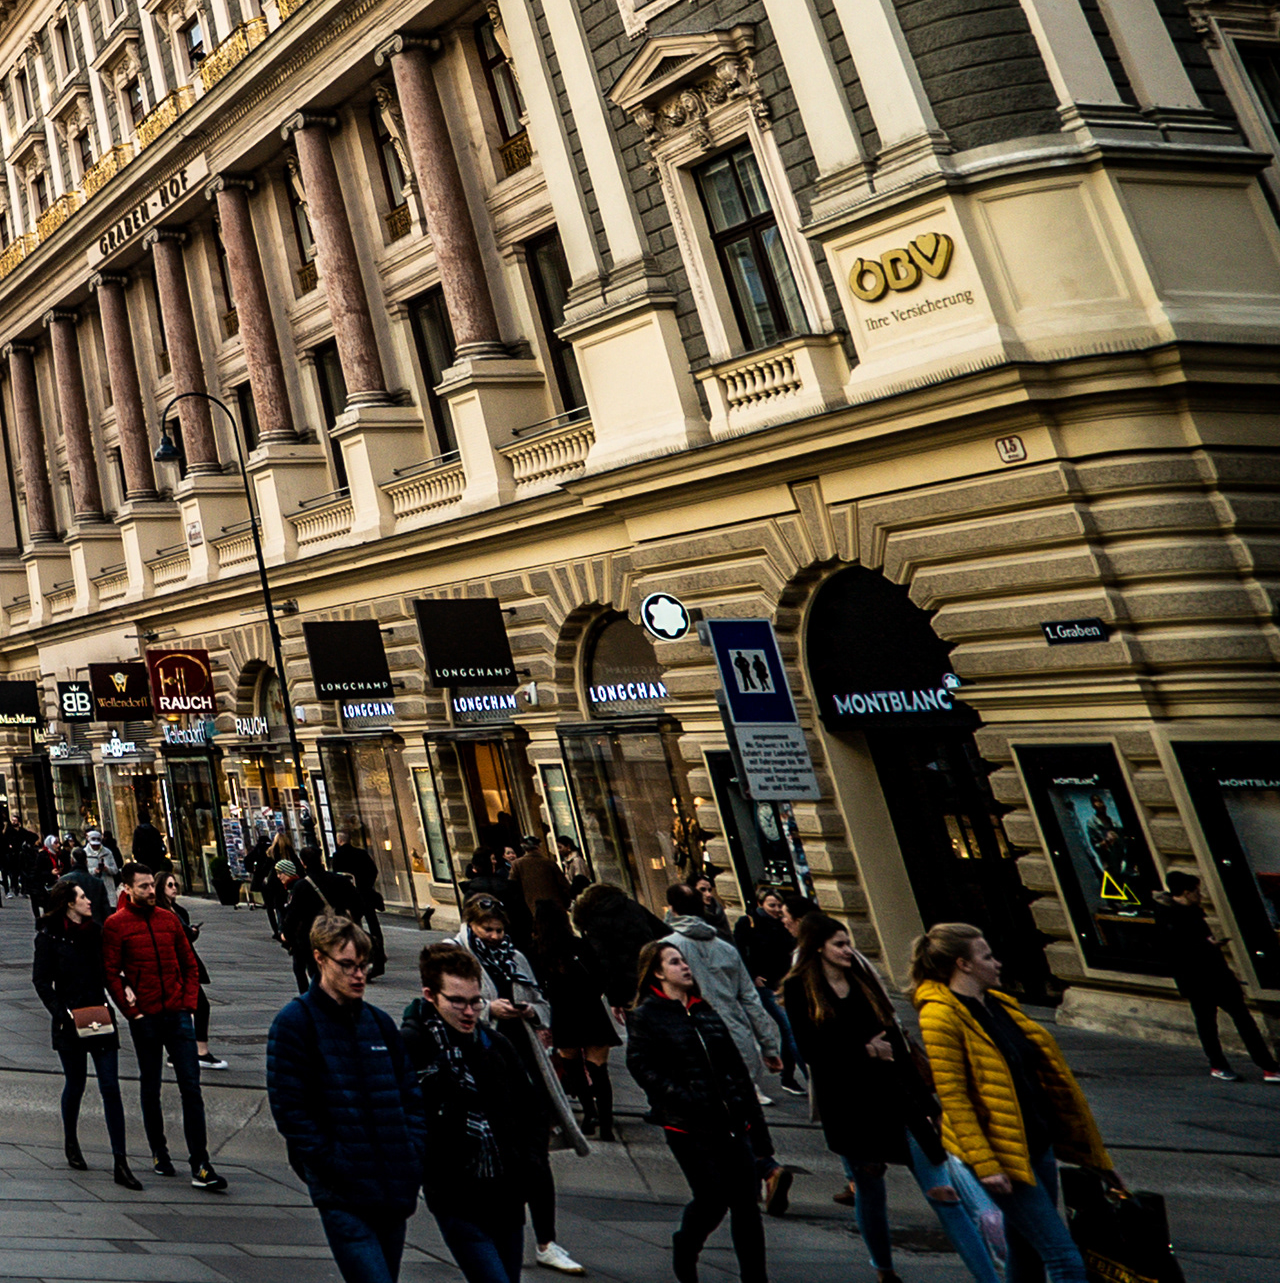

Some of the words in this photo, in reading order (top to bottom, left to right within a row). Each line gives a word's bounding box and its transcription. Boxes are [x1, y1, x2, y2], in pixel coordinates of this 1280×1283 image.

[100, 202, 150, 255] GRABEN
[159, 169, 188, 207] HOF
[865, 316, 891, 331] Ihre
[891, 290, 975, 322] Versicherung
[1001, 439, 1018, 454] 15
[1056, 624, 1100, 638] Graben
[435, 668, 512, 678] LONGCHAMP
[320, 681, 389, 692] LONGCHAMP
[97, 697, 148, 708] Wellendorff
[159, 696, 213, 710] RAUCH
[833, 688, 952, 714] MONTBLANC
[162, 721, 206, 744] Wellendorff
[234, 716, 269, 736] RAUCH
[1052, 778, 1095, 786] MONTBLANC
